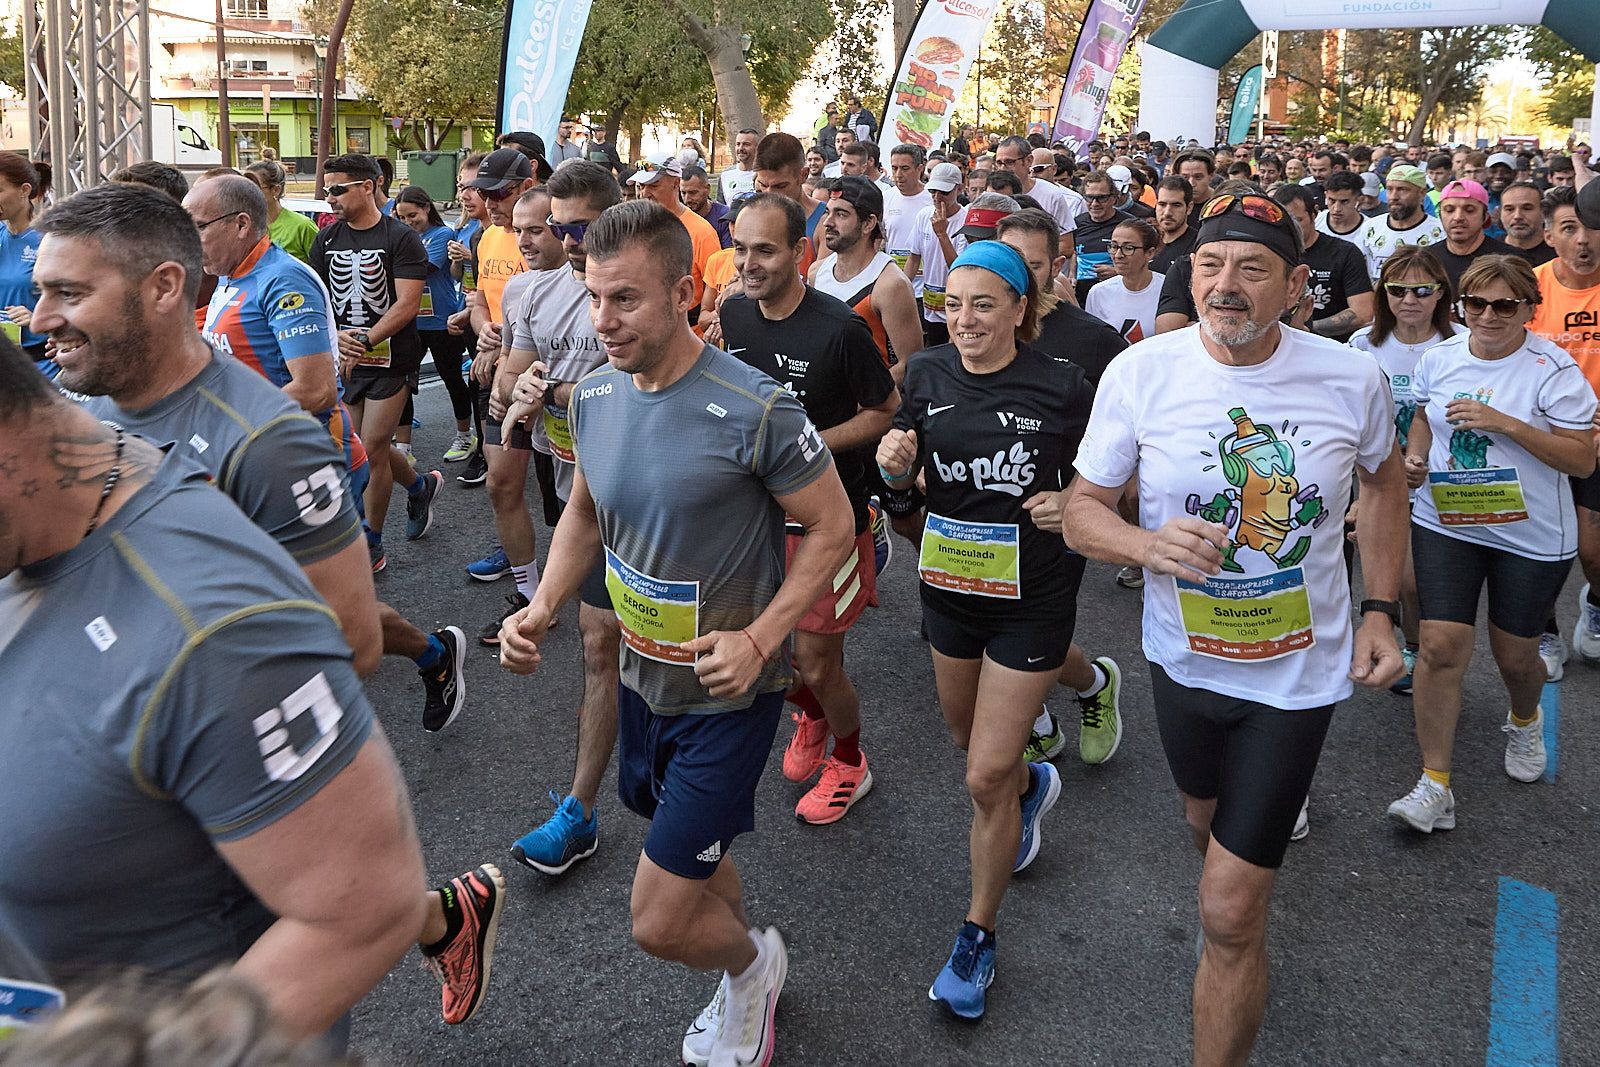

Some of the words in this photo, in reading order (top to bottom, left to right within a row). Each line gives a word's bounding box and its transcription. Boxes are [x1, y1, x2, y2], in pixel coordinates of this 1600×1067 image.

[937, 0, 990, 19] ulcesol
[1343, 0, 1432, 12] FUNDACIÓN
[561, 27, 576, 51] ICE
[909, 62, 937, 81] NO
[491, 259, 525, 275] ECSA
[278, 324, 319, 340] ALPESA
[787, 358, 810, 368] VICKY
[788, 365, 807, 373] FOODS
[1393, 375, 1408, 385] 50
[1015, 416, 1042, 428] VICKY
[933, 451, 967, 482] be
[969, 449, 1037, 491] plus
[1460, 489, 1506, 497] Natividad
[942, 522, 960, 532] CURSA
[938, 544, 995, 559] Inmaculada
[948, 557, 964, 565] VICKY
[1205, 580, 1231, 590] CURSA
[1237, 578, 1274, 590] EMPRESES
[1221, 589, 1248, 597] SAFOR
[623, 593, 659, 617] SERGIO
[1213, 606, 1274, 618] Salvador
[1210, 619, 1243, 628] Refresco
[1266, 616, 1282, 626] SAU
